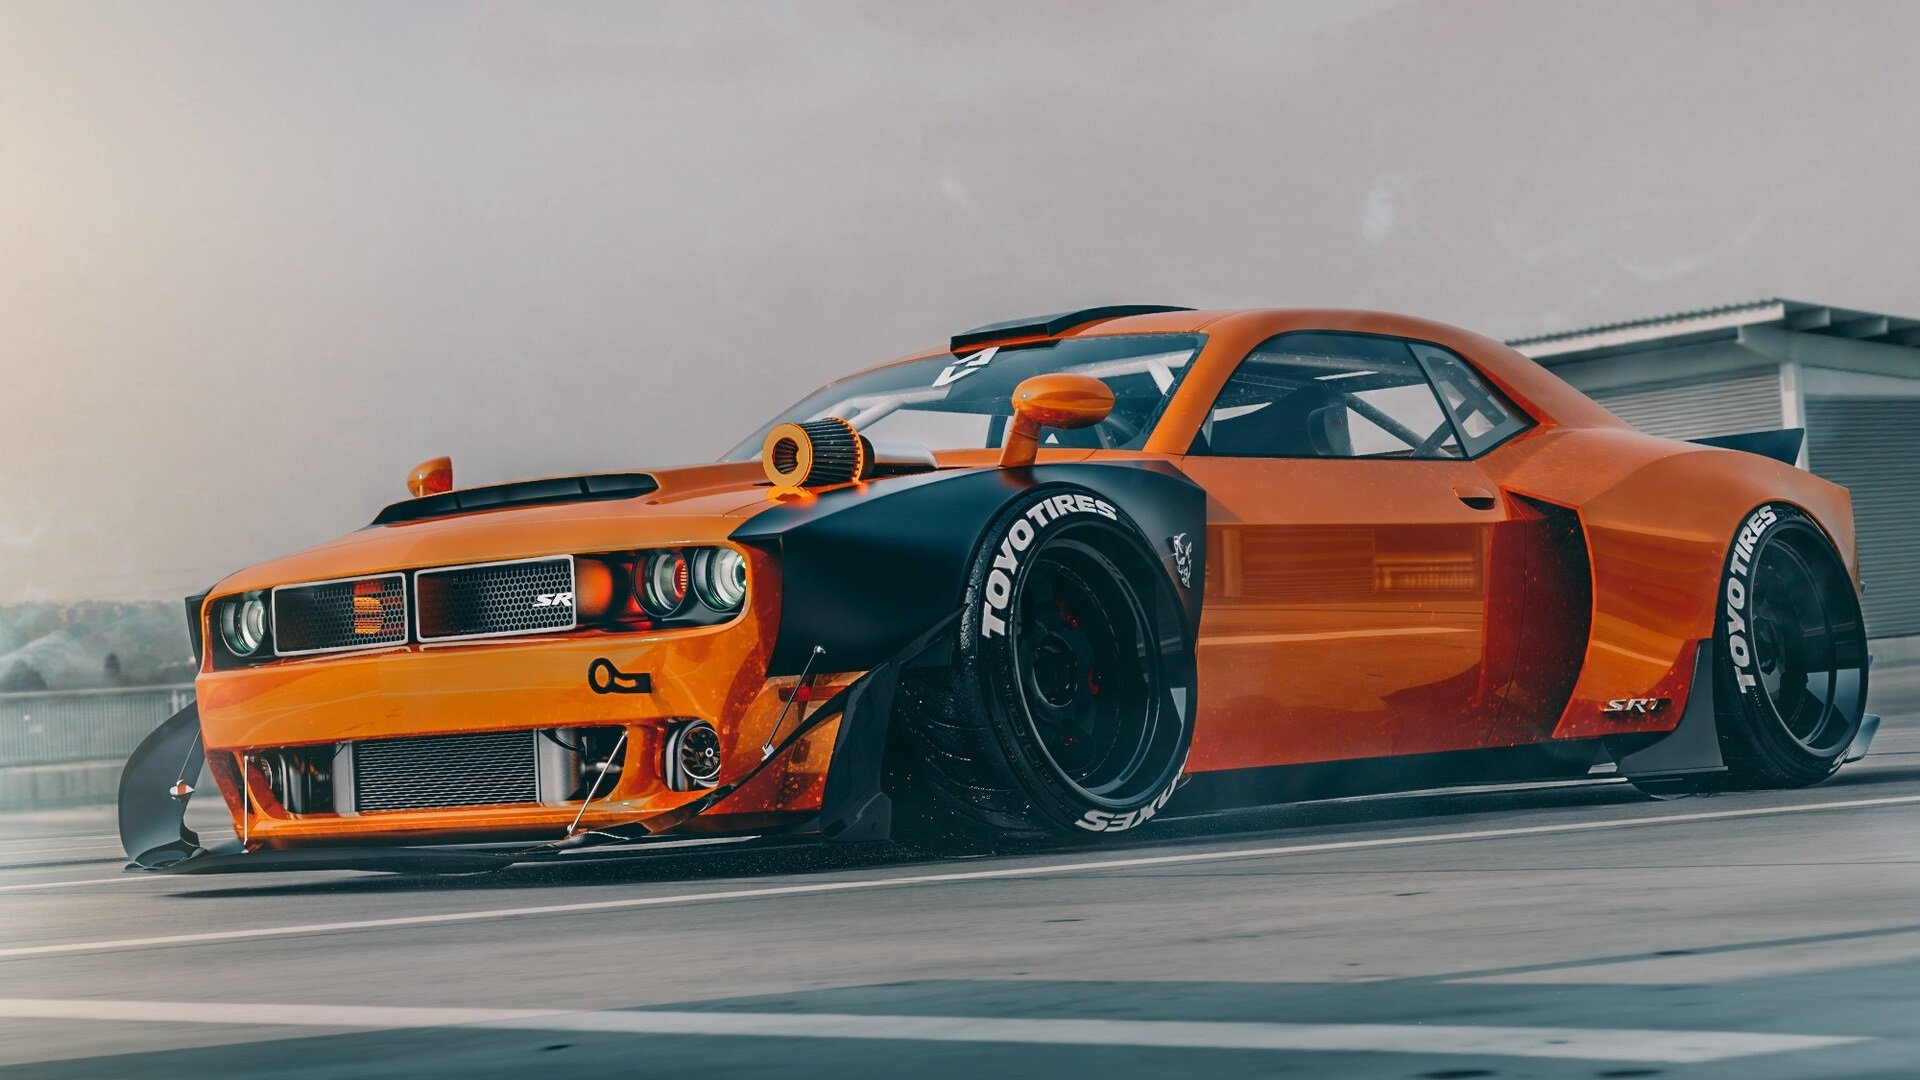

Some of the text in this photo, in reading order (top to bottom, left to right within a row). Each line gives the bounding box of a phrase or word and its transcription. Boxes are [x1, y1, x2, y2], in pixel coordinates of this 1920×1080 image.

[982, 518, 1035, 639] TOYO
[1026, 494, 1118, 528] TIRES
[1727, 504, 1778, 694] TOYO TIRES
